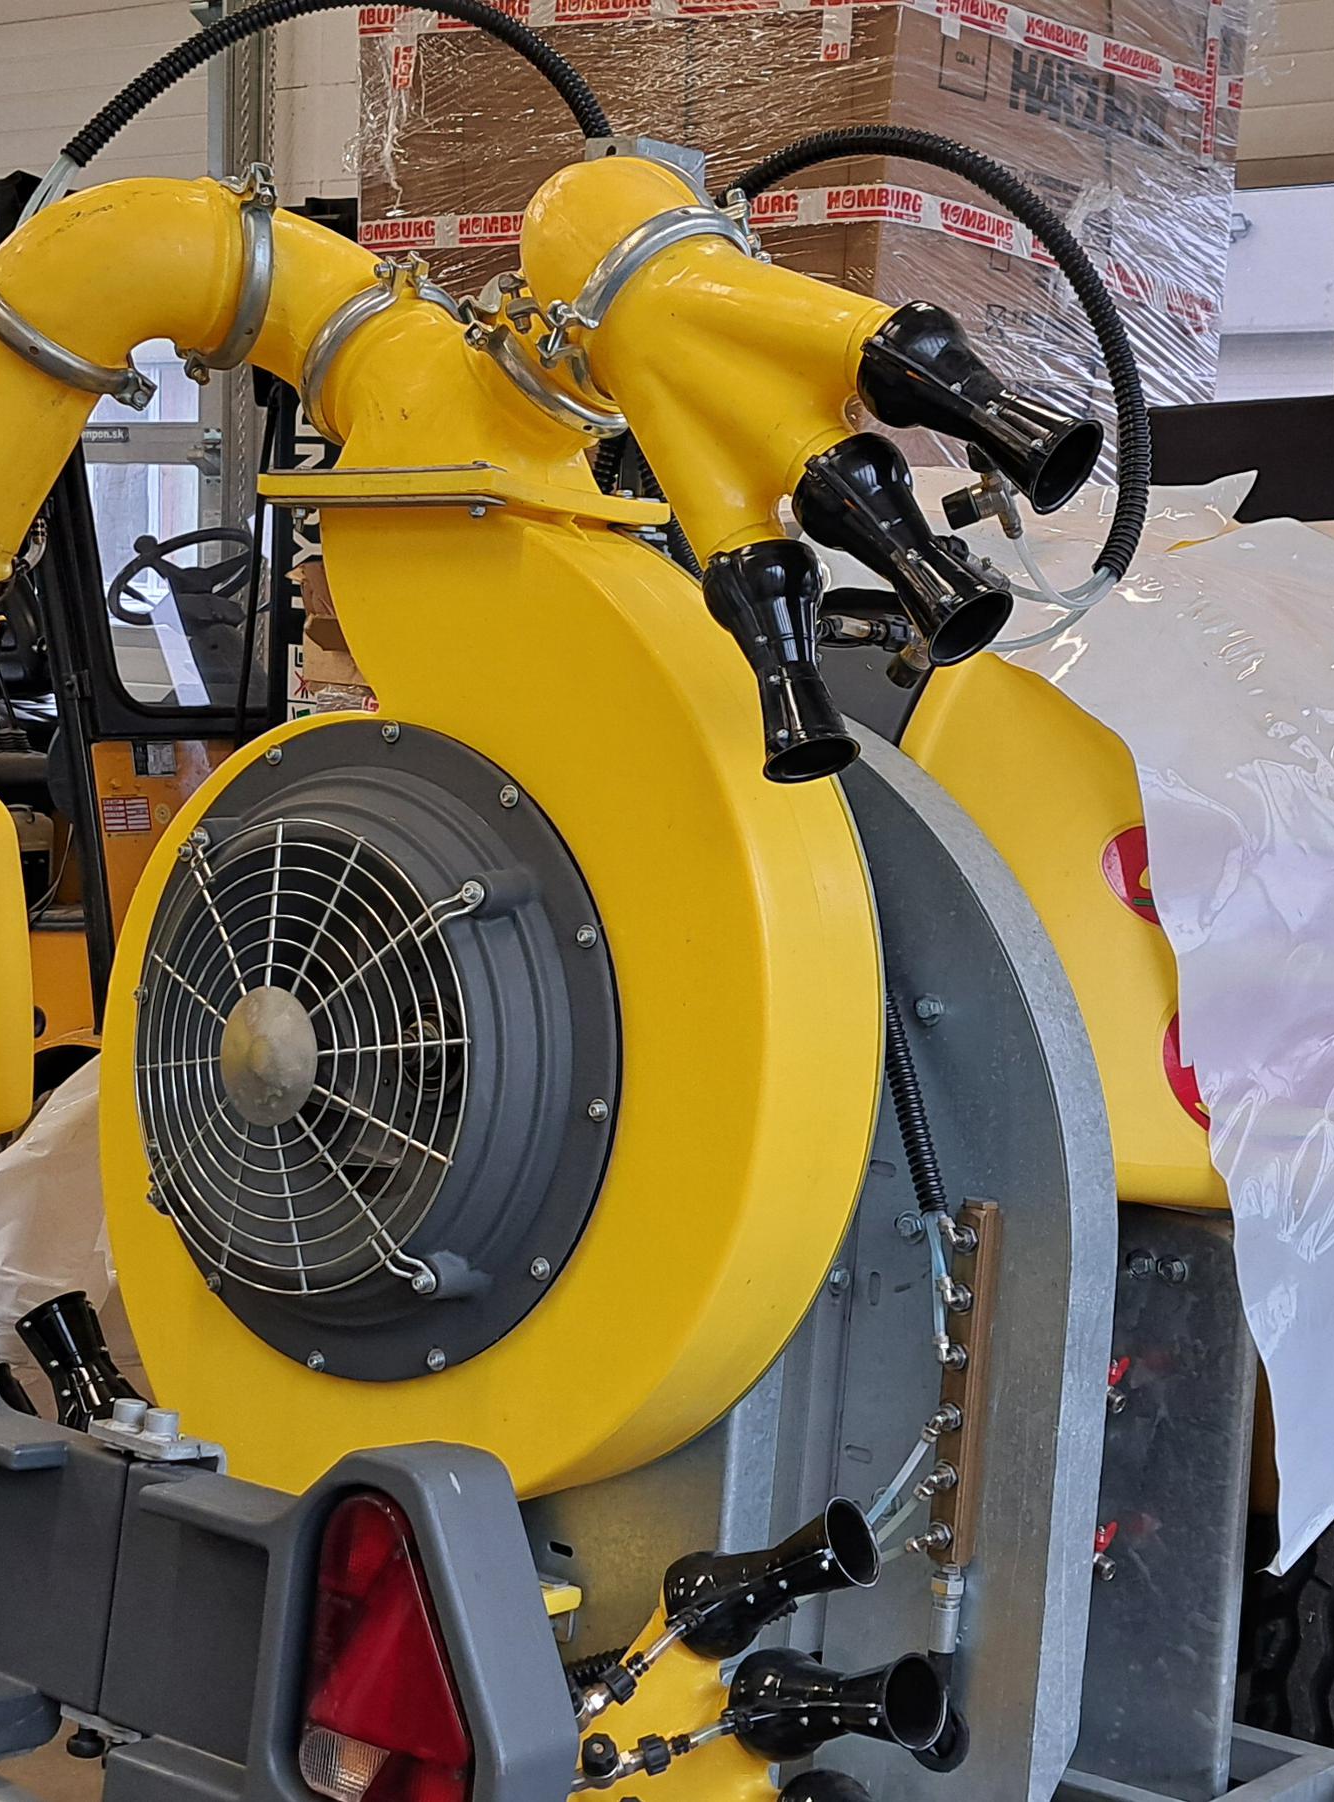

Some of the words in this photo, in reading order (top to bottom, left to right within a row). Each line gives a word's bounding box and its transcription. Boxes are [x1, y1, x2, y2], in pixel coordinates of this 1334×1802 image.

[1025, 15, 1088, 52] HOMBURG
[1103, 41, 1162, 74] HOMBURG
[827, 187, 922, 212] HOMBURG
[458, 215, 525, 236] HOMBU
[940, 201, 1014, 241] HOMBURG
